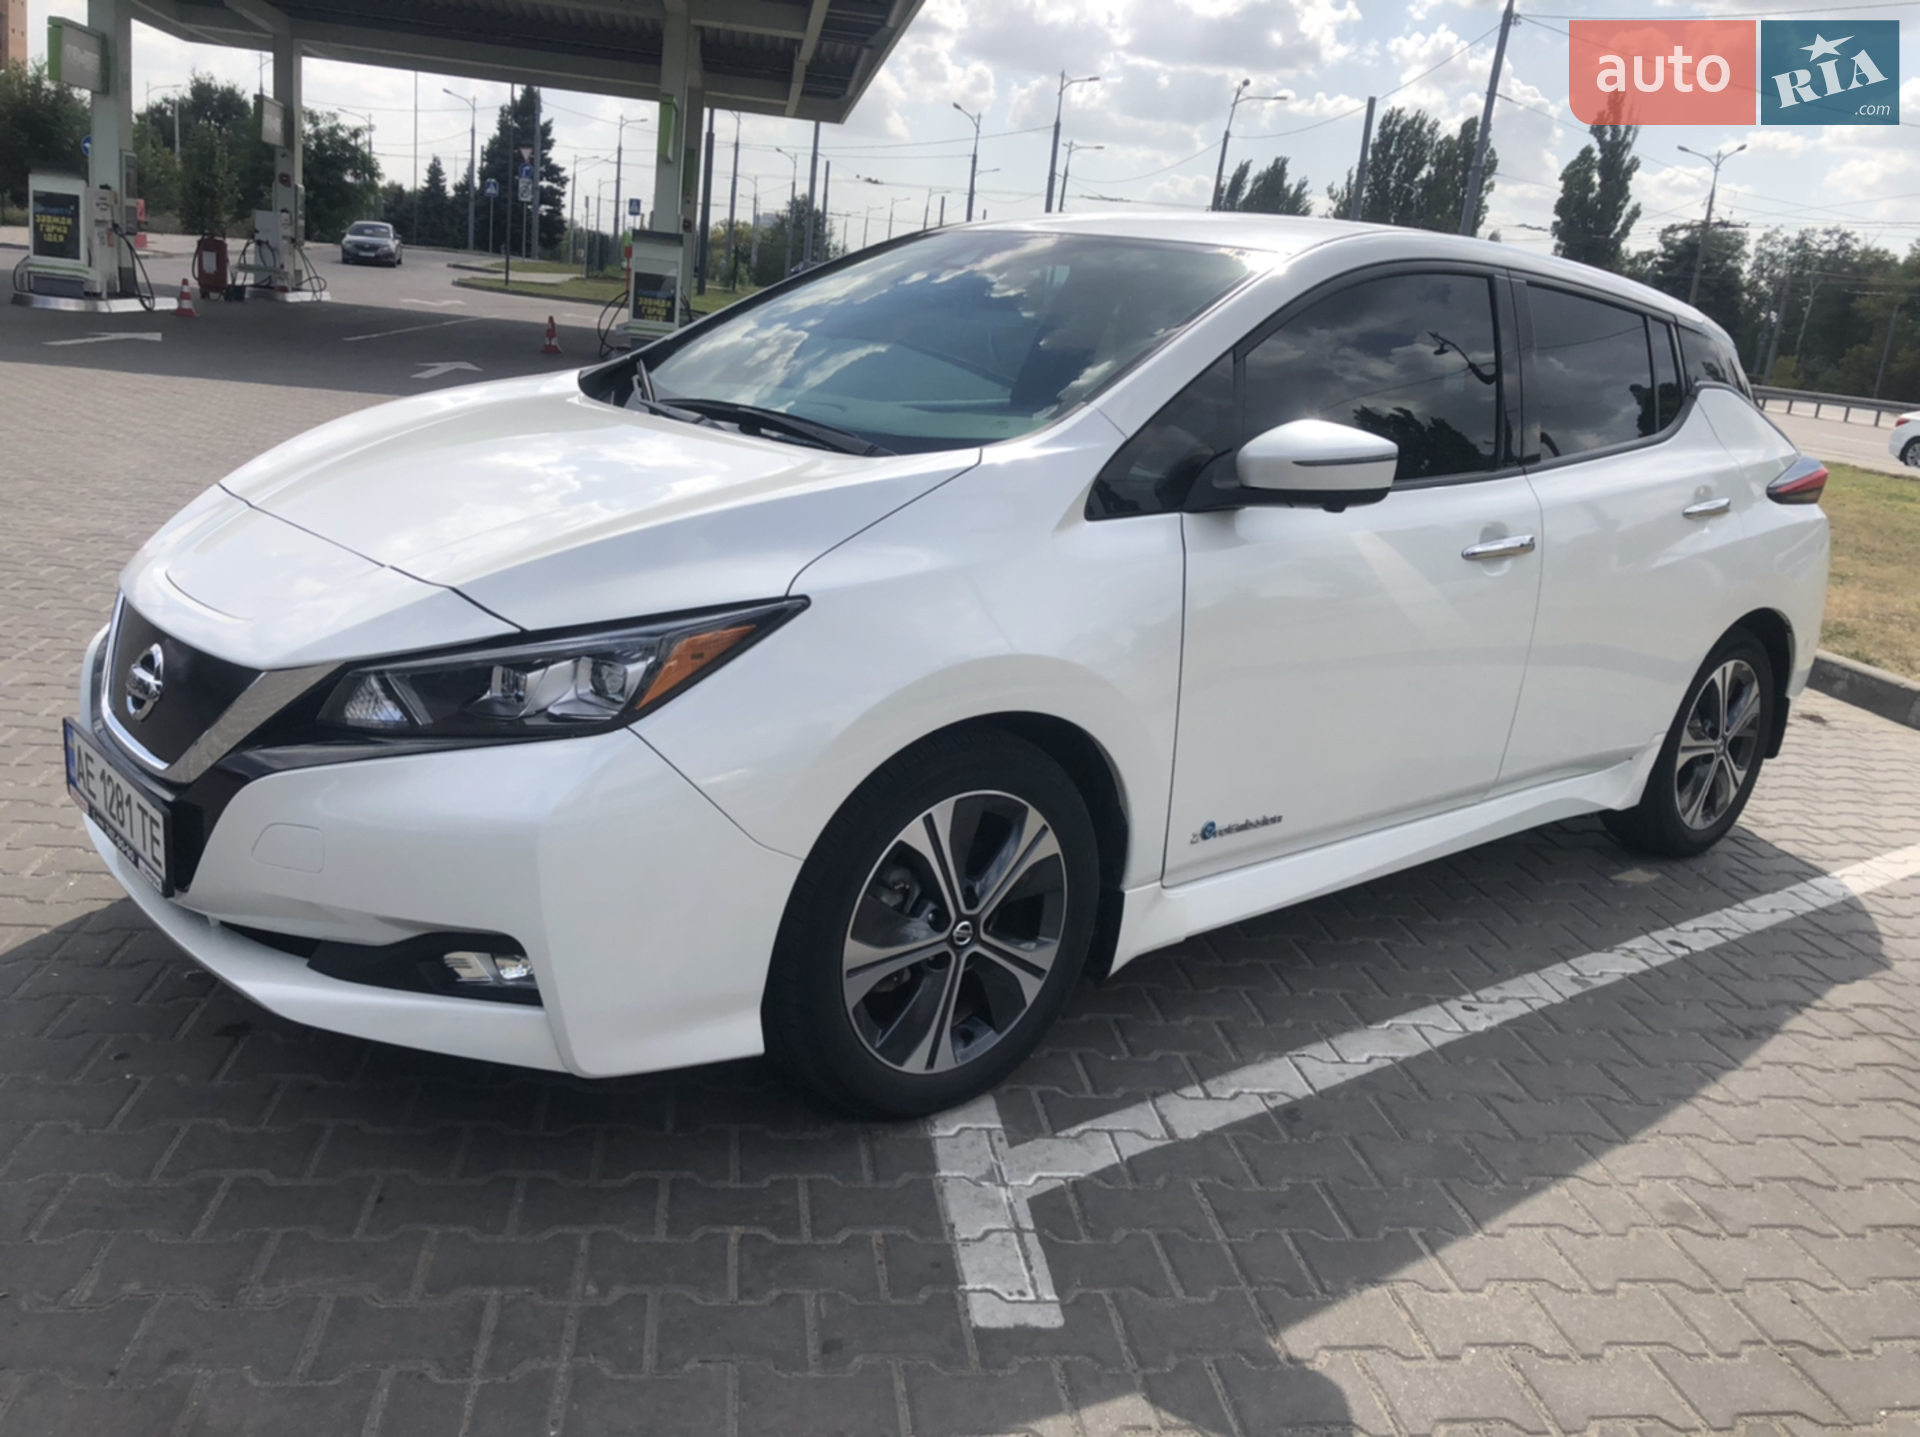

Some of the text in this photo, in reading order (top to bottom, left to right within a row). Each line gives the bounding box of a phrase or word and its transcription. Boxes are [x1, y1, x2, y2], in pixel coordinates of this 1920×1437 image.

[35, 214, 72, 225] ЗАВЖДИ
[76, 744, 97, 801] AE
[100, 768, 134, 840] 1281
[136, 801, 163, 870] TE
